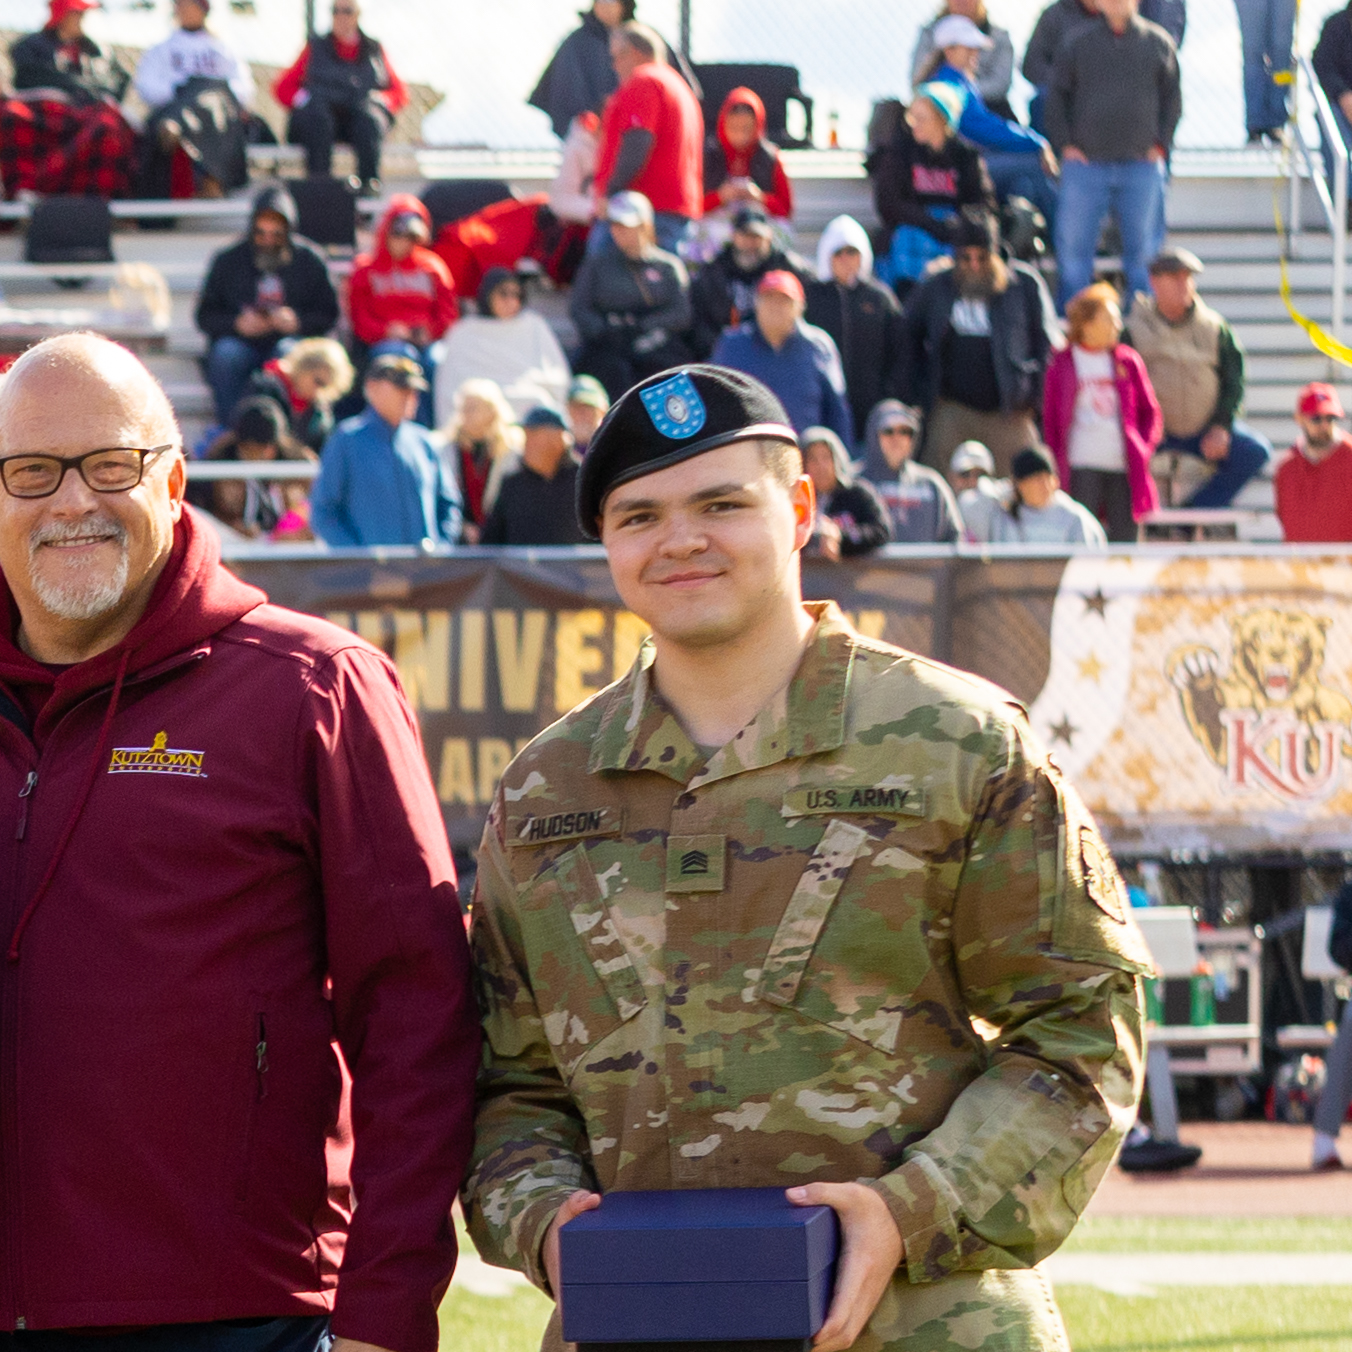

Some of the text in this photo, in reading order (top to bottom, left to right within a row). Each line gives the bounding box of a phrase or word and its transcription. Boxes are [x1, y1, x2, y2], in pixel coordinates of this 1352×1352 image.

[111, 750, 204, 768] KUTZTOWN
[1219, 708, 1344, 800] KU
[806, 788, 911, 810] U.S. ARMY
[529, 810, 601, 841] HUDSON
